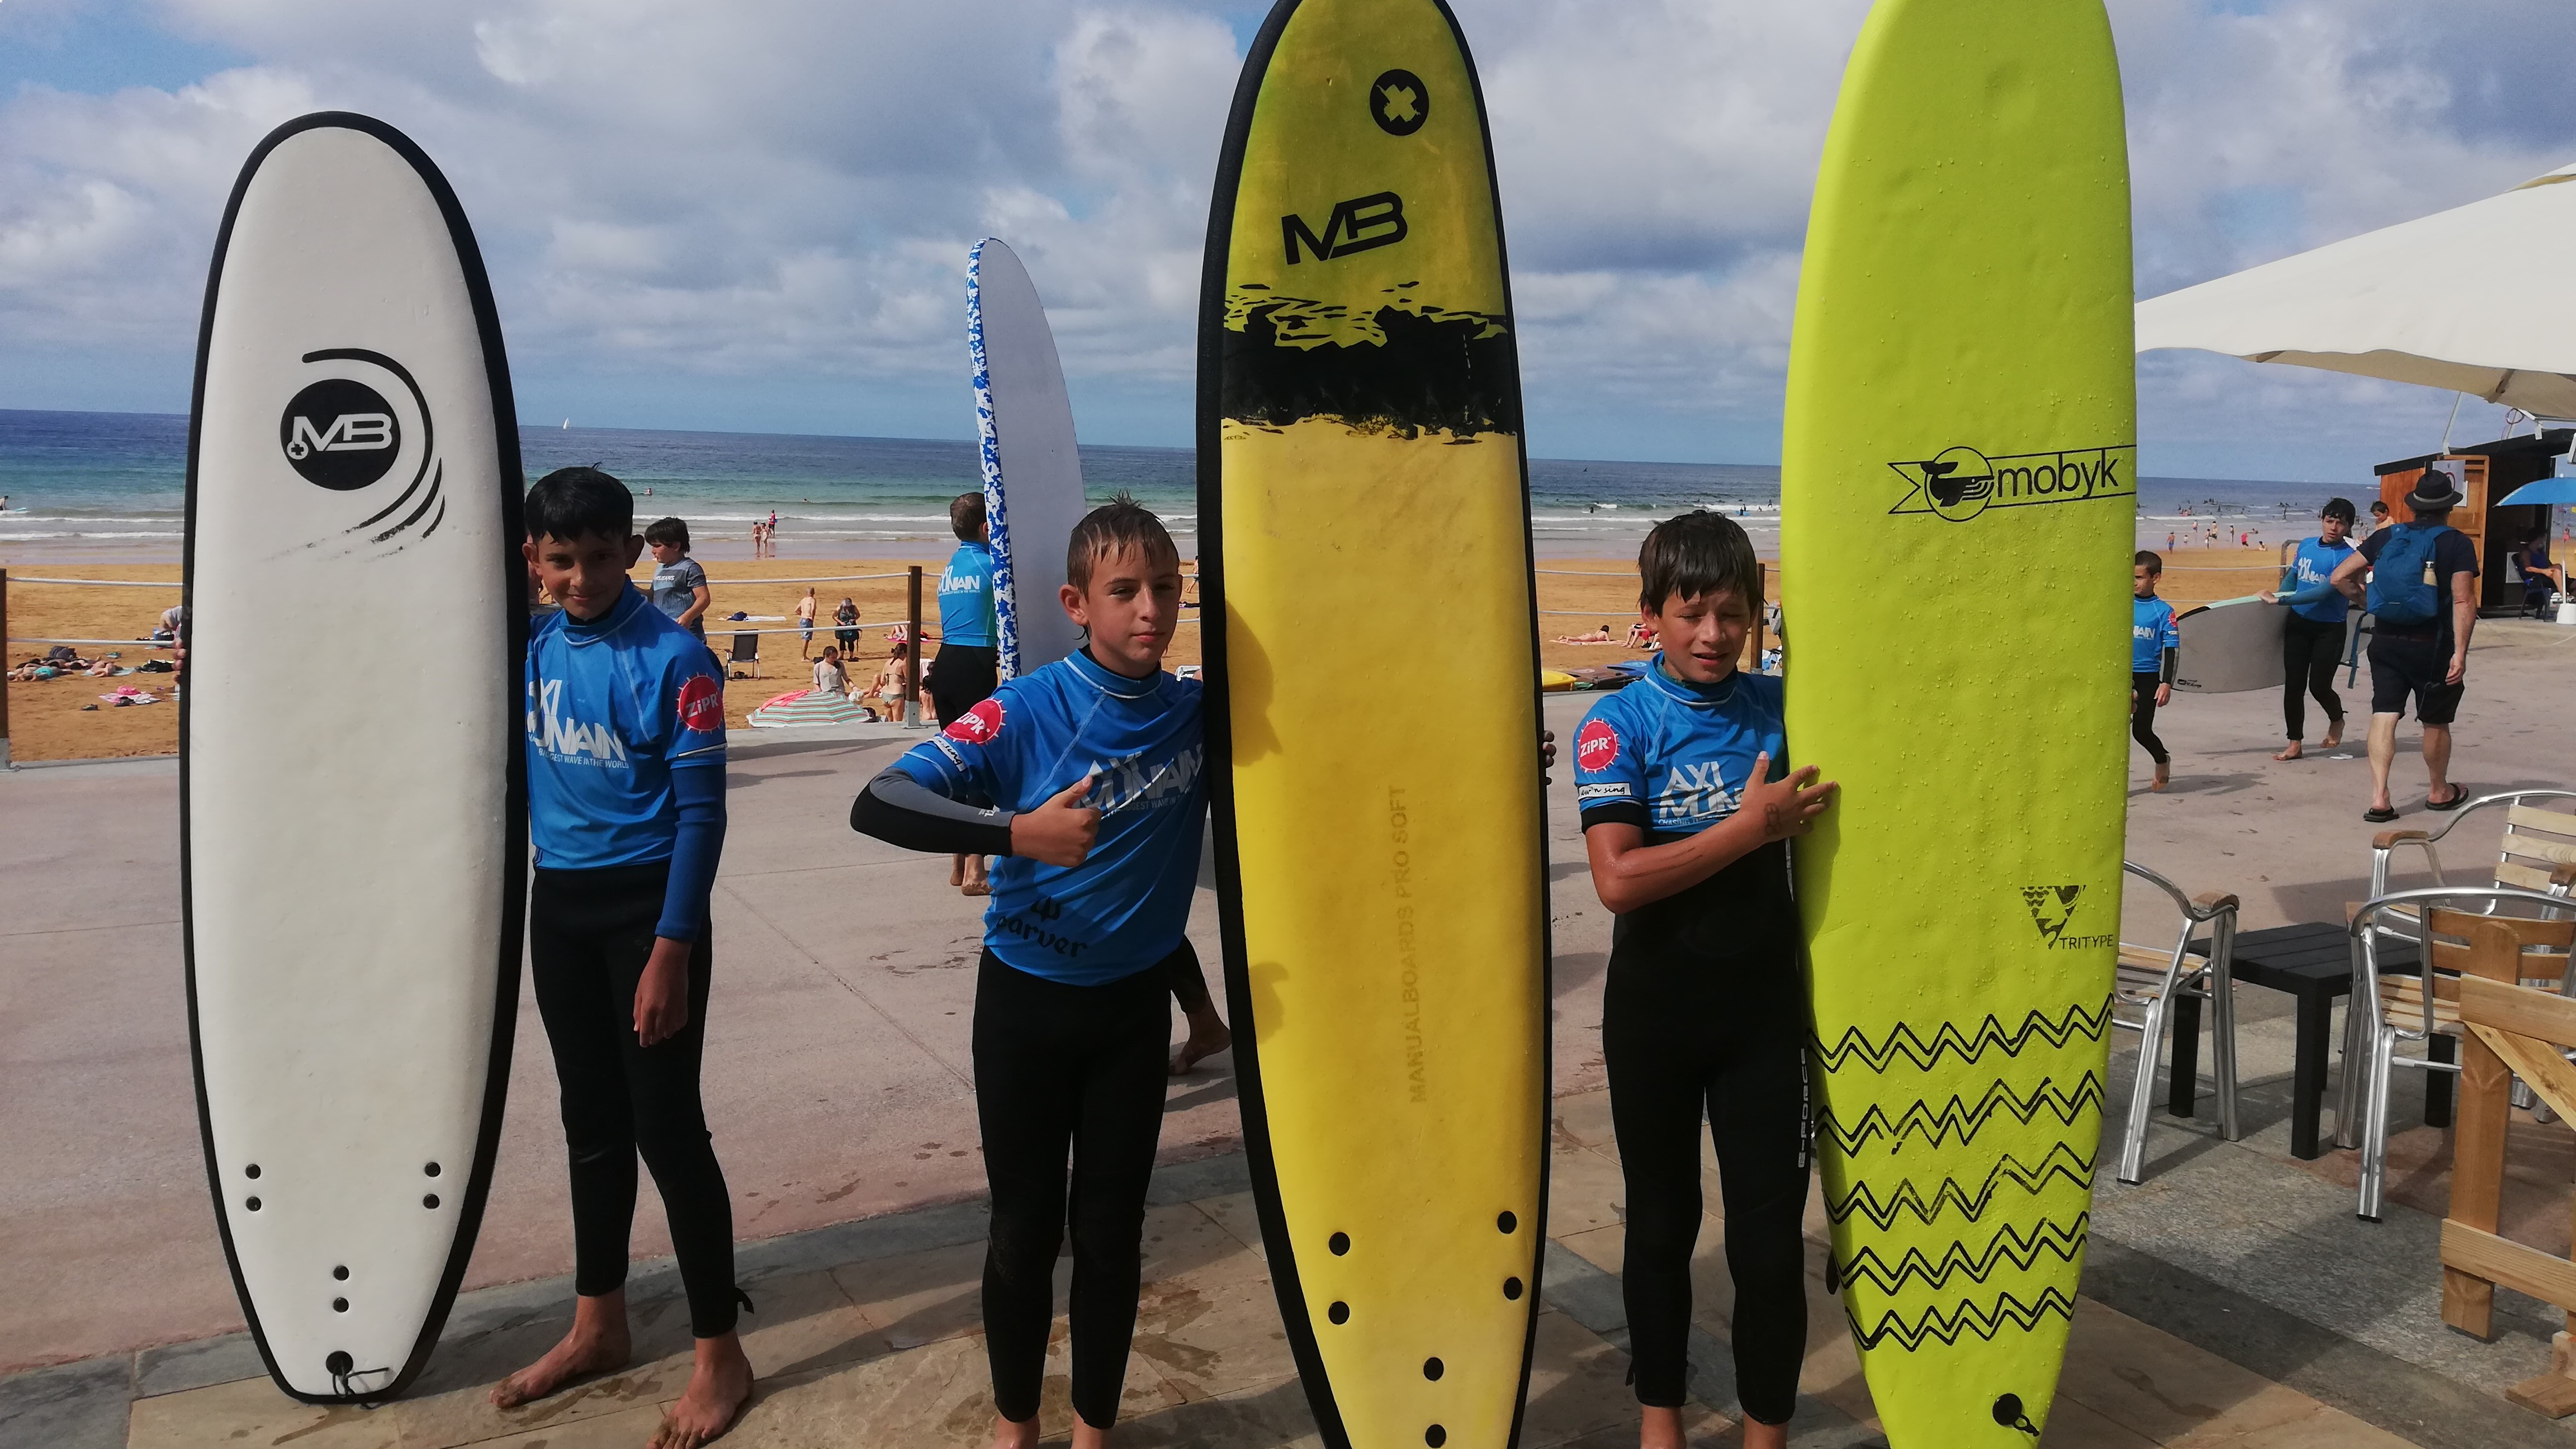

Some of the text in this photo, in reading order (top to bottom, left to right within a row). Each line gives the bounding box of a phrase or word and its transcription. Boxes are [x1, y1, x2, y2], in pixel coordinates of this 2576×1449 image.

[1281, 191, 1408, 266] MB
[291, 413, 392, 454] MB
[1997, 449, 2119, 498] mobyk
[538, 747, 564, 764] BIGGEST
[564, 755, 583, 766] WAVE
[589, 758, 604, 768] THE
[605, 760, 629, 770] WORLD
[1388, 785, 1428, 1104] MANUALBOARDS PRO SOFT
[2059, 934, 2114, 950] TRITYPE
